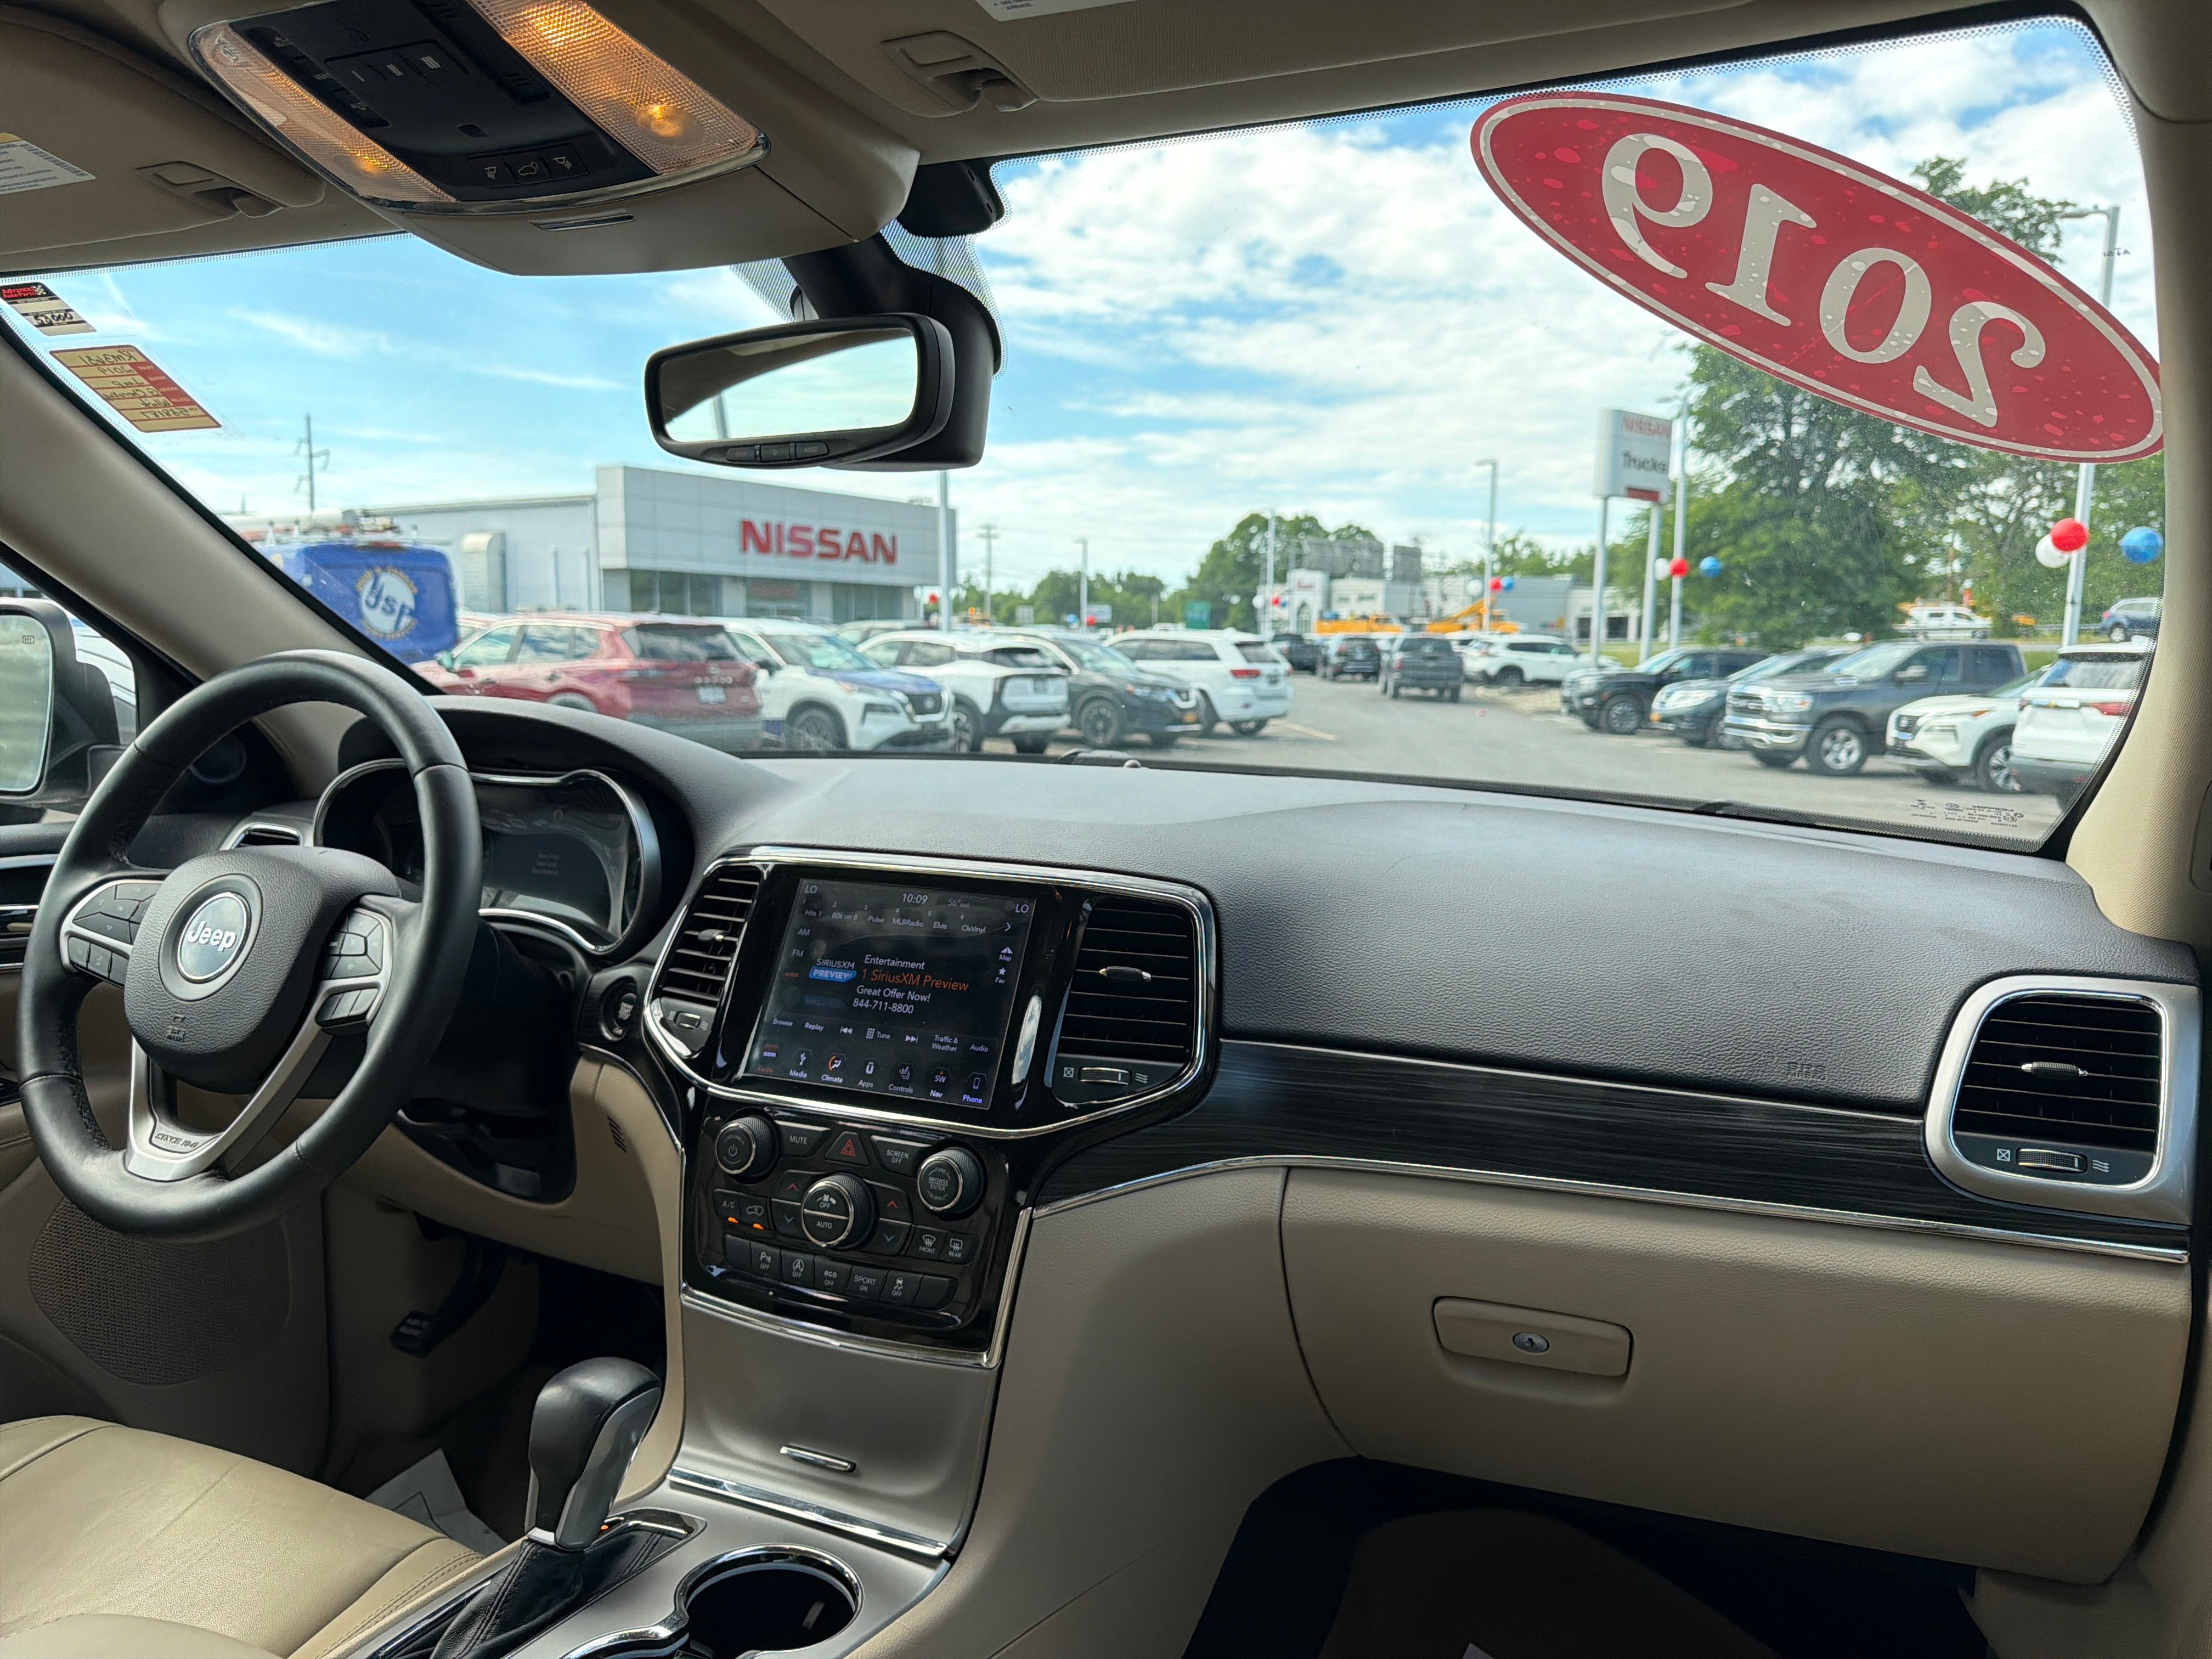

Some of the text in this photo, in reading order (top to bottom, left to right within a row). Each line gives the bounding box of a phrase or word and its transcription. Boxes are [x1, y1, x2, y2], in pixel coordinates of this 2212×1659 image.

[1622, 450, 1669, 474] Trucks
[740, 518, 898, 566] NISSAN
[805, 884, 817, 894] LO
[902, 893, 928, 904] 10:09
[1015, 904, 1029, 913] LO
[892, 918, 924, 927] MLBRadio
[187, 921, 236, 952] Jeep
[792, 949, 804, 957] FM
[816, 958, 855, 969] SIRIUSXM
[864, 954, 926, 969] Entertainment
[812, 969, 853, 979] PREVIEW
[862, 968, 969, 991] 1 SiriusXM Preview
[856, 985, 931, 1002] Great Offer Now!
[853, 998, 914, 1014] 844-711-8800
[772, 1018, 793, 1026] Browse
[804, 1022, 825, 1032] Replay
[877, 1031, 891, 1040] Tune
[934, 1035, 952, 1043] Traffic
[932, 1043, 958, 1052] Weather
[970, 1044, 989, 1053] Audio
[1787, 1062, 1826, 1073] SRS
[789, 1069, 808, 1079] Media
[821, 1074, 843, 1084] Climate
[934, 1075, 946, 1083] SW
[858, 1080, 874, 1088] Apps
[888, 1084, 913, 1093] Controls
[962, 1094, 983, 1104] Phone
[789, 1135, 808, 1144] MUTE
[887, 1149, 909, 1159] SCREEN
[929, 1176, 949, 1184] BROWSE
[930, 1183, 946, 1192] ENTER
[722, 1200, 735, 1209] A/C
[816, 1221, 833, 1229] AUTO
[824, 1270, 838, 1278] eco
[854, 1274, 876, 1286] SPORT
